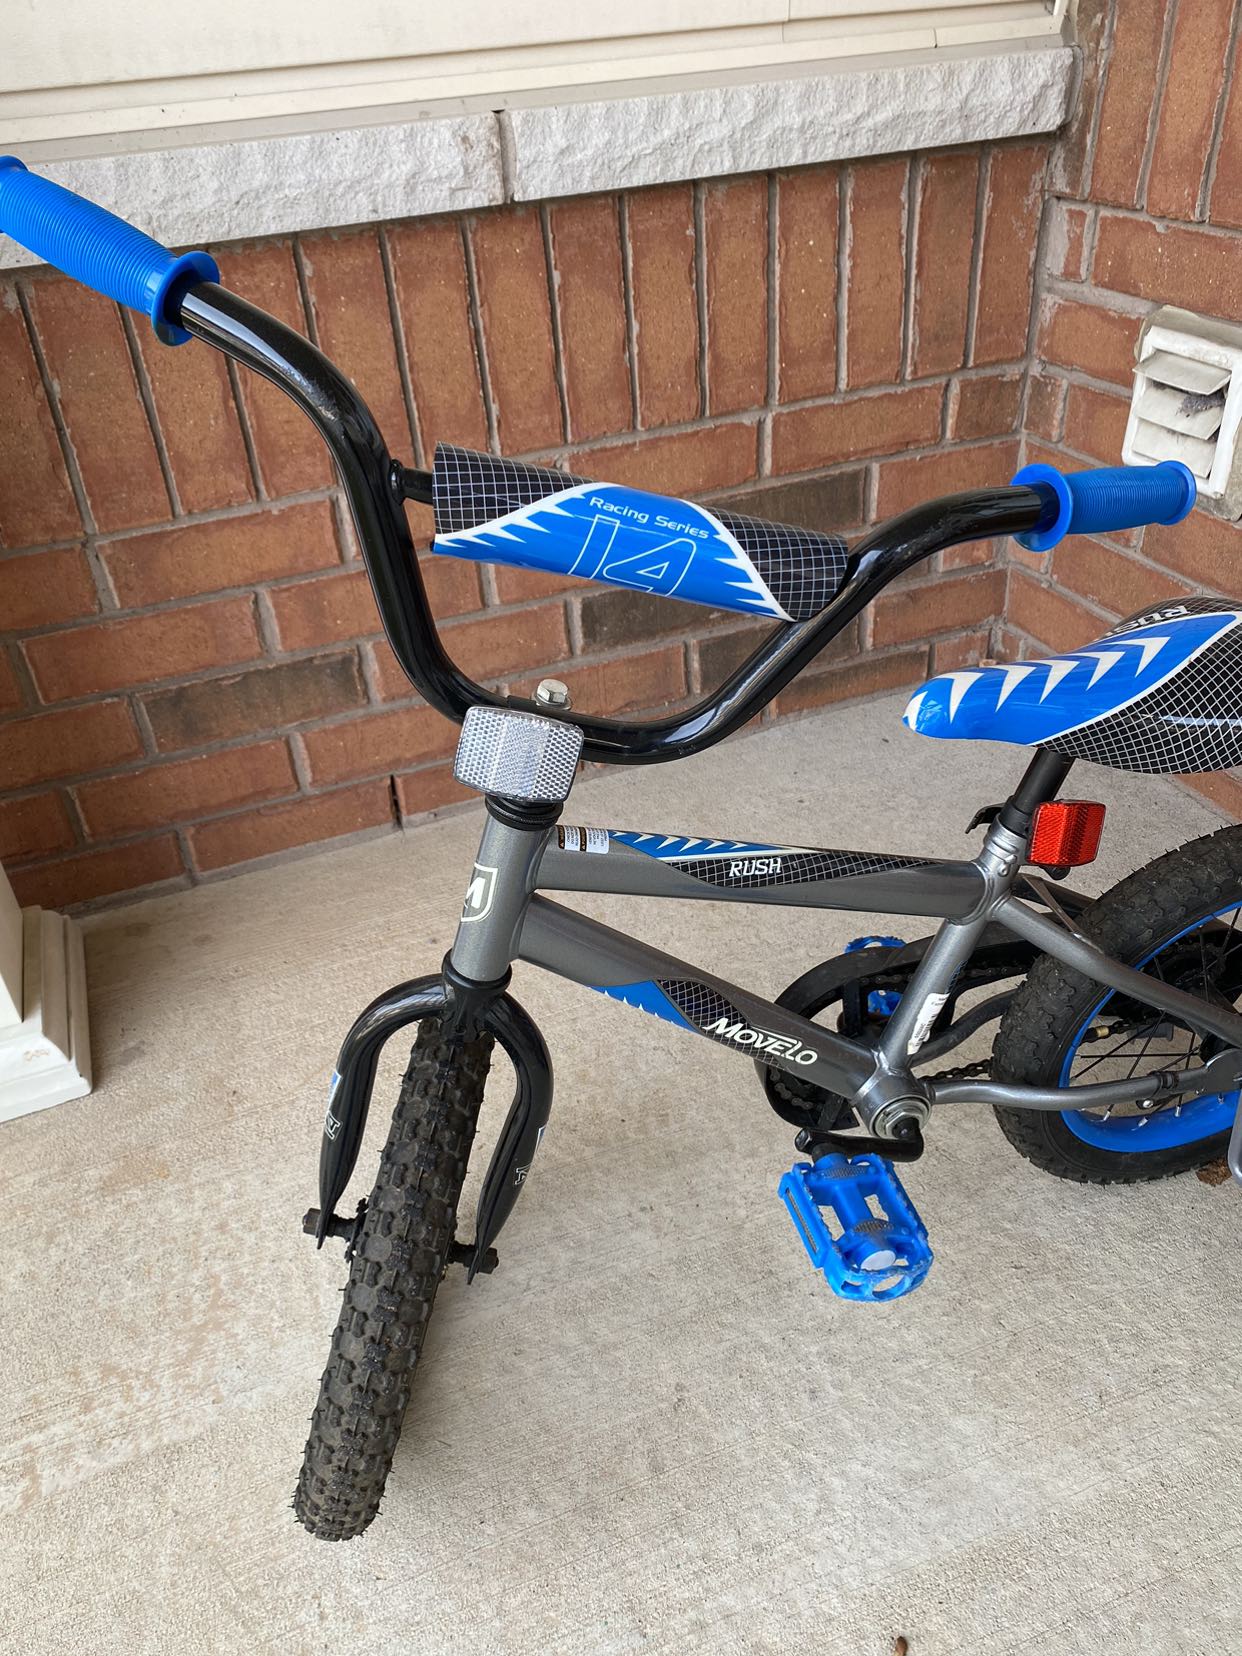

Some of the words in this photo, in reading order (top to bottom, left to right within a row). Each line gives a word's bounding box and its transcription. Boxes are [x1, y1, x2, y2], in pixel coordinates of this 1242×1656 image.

[589, 496, 649, 524] Racing
[654, 515, 709, 539] Series
[566, 514, 697, 597] 14
[1105, 605, 1191, 636] RUS
[728, 857, 782, 877] RUSH
[702, 1017, 818, 1065] MOVELO
